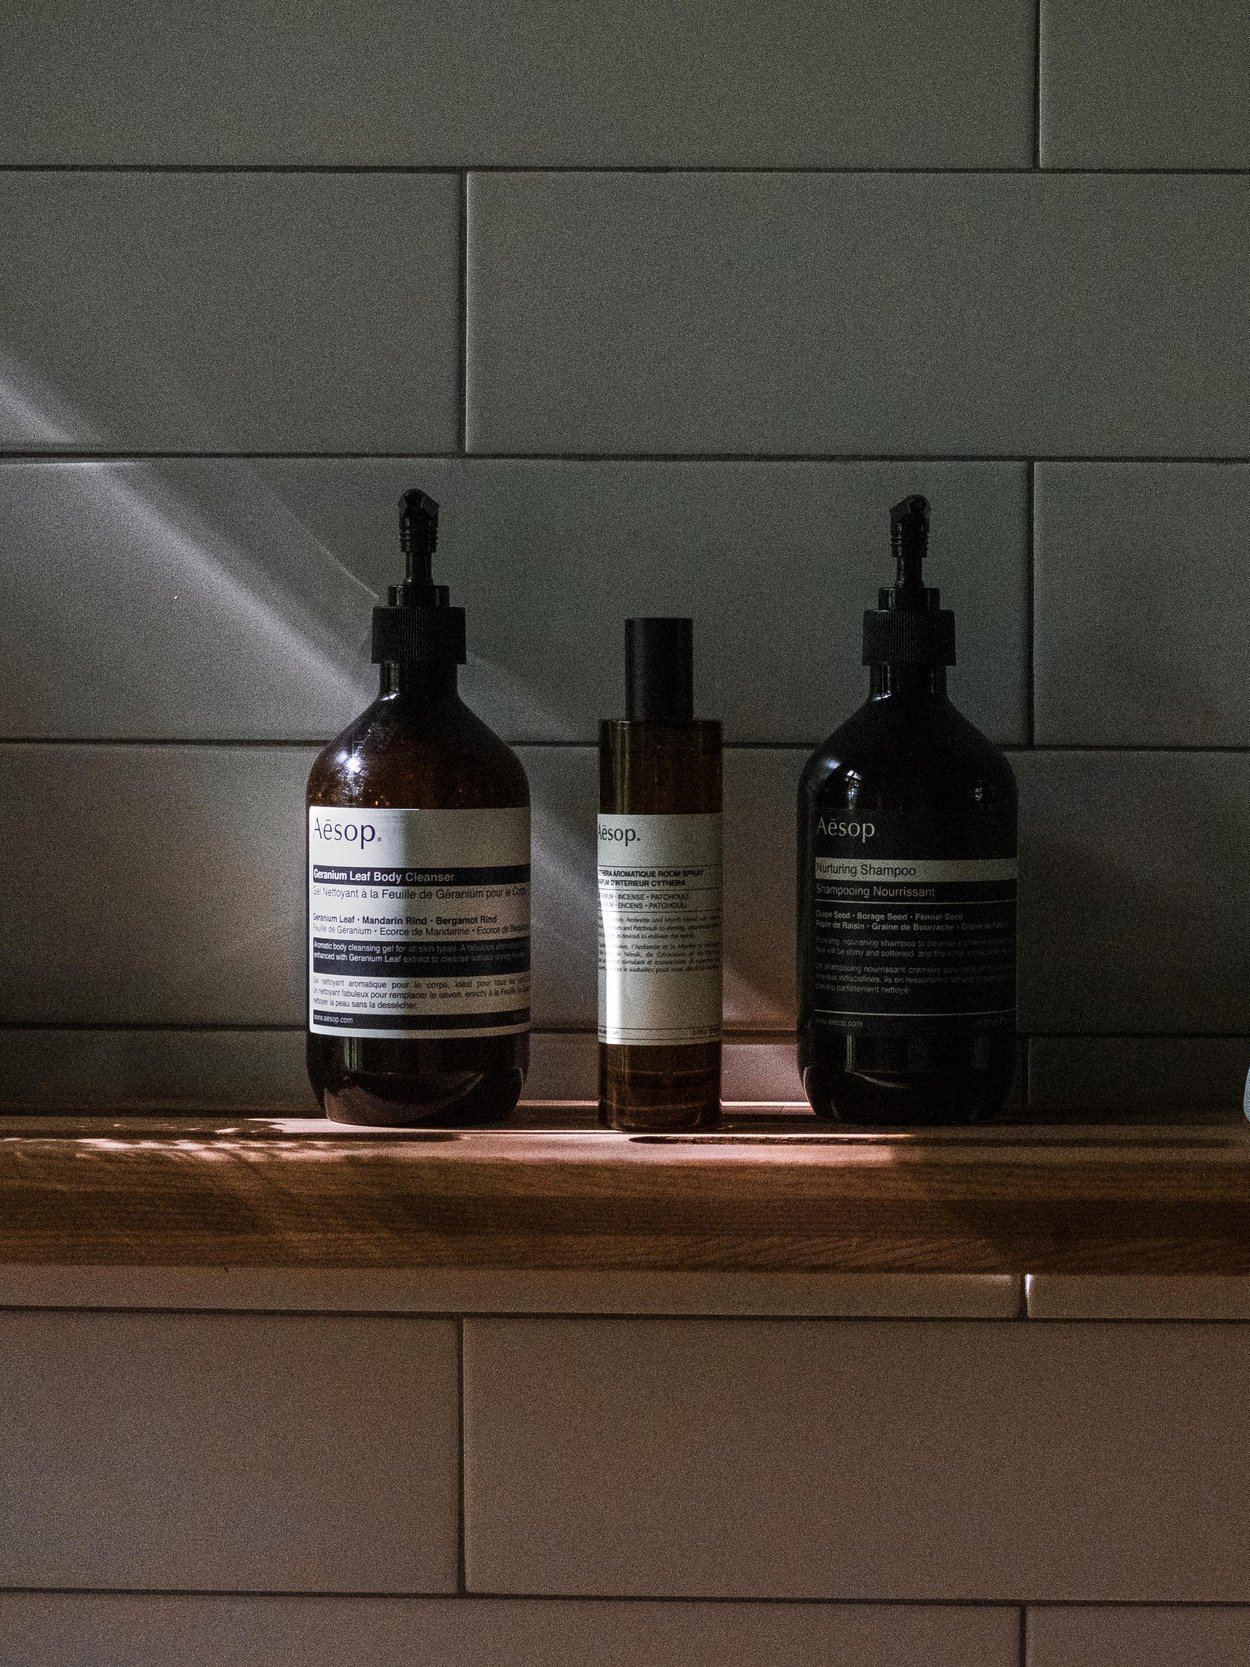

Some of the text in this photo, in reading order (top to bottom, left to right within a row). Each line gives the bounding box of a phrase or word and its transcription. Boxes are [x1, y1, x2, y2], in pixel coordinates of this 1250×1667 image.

[816, 861, 917, 878] Nurturing Shampoo
[314, 868, 456, 884] Geranium Leaf Body Cleanser
[322, 886, 359, 900] Nettoyant
[361, 888, 367, 899] à
[370, 888, 379, 899] la
[382, 888, 416, 899] Feuille
[419, 889, 433, 899] de
[436, 888, 484, 899] Géranium
[486, 889, 503, 901] pour
[816, 883, 935, 899] Shampooing Nourrissant
[339, 914, 355, 923] Leaf
[362, 915, 403, 925] Mandarin
[405, 916, 427, 925] Rind
[435, 916, 478, 926] Bergamot
[480, 915, 497, 924] Rind
[833, 910, 851, 919] Seed
[856, 911, 886, 922] Borage
[886, 912, 908, 921] Seed
[915, 912, 943, 921] Fennel
[379, 927, 411, 936] Ecorce
[842, 921, 865, 930] Raisin
[871, 922, 899, 931] Graine
[900, 922, 911, 931] de
[913, 922, 955, 931] Bourrache
[333, 943, 347, 953] body
[348, 944, 381, 954] cleansing
[382, 945, 394, 954] gel
[880, 939, 917, 949] shampoo
[349, 953, 402, 963] Geranium Leaf
[348, 981, 387, 990] aromatique
